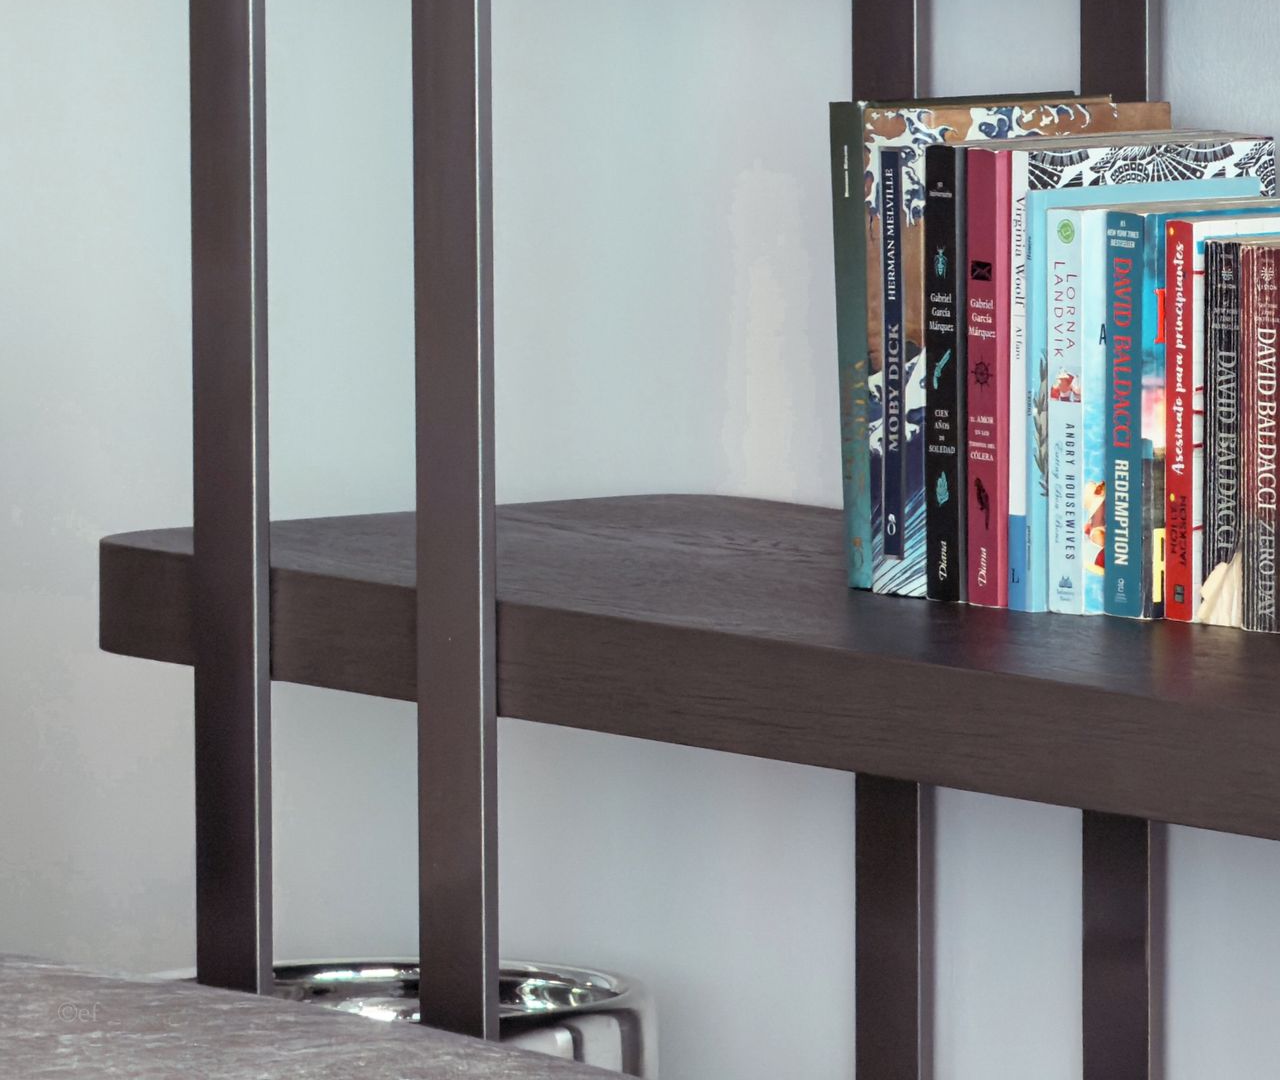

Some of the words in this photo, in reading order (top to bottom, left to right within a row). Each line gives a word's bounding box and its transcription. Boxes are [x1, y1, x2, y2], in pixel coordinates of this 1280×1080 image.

[885, 168, 895, 237] MELVILLE
[1014, 196, 1025, 257] Virginia
[887, 239, 897, 301] HERMAN
[930, 292, 952, 303] Gabriel
[1015, 264, 1025, 308] Woolf
[1113, 257, 1133, 328] DAVID
[1172, 241, 1186, 349] principiantes
[929, 320, 954, 332] Márquez
[931, 306, 951, 317] García
[968, 326, 996, 339] Márquez
[970, 298, 994, 310] Gabriel
[972, 312, 993, 323] García
[1054, 261, 1066, 358] LANDVIK
[1066, 273, 1077, 351] LORNA
[888, 323, 899, 380] DICK
[1175, 353, 1186, 392] para
[1257, 327, 1276, 396] DAVID
[934, 409, 949, 418] CIEN
[1113, 335, 1132, 448] BALDACCI
[1217, 351, 1237, 424] DAVID
[888, 385, 899, 452] MOBY
[934, 420, 950, 430] AÑOS
[1065, 423, 1075, 465] ANGRY
[1171, 397, 1185, 475] Asesinato
[928, 445, 956, 455] SOLEDAD
[970, 450, 994, 461] CÓLERA
[1257, 401, 1276, 510] BALDACCI
[1065, 474, 1075, 560] HOUSEWIVES
[1114, 460, 1129, 565] REDEMPTION
[1217, 432, 1237, 549] BALDACCI
[1179, 495, 1187, 567] JACKSON
[1258, 519, 1276, 575] ZERO
[938, 540, 947, 581] Diana
[978, 546, 987, 587] Diana
[1258, 578, 1275, 619] DAY
